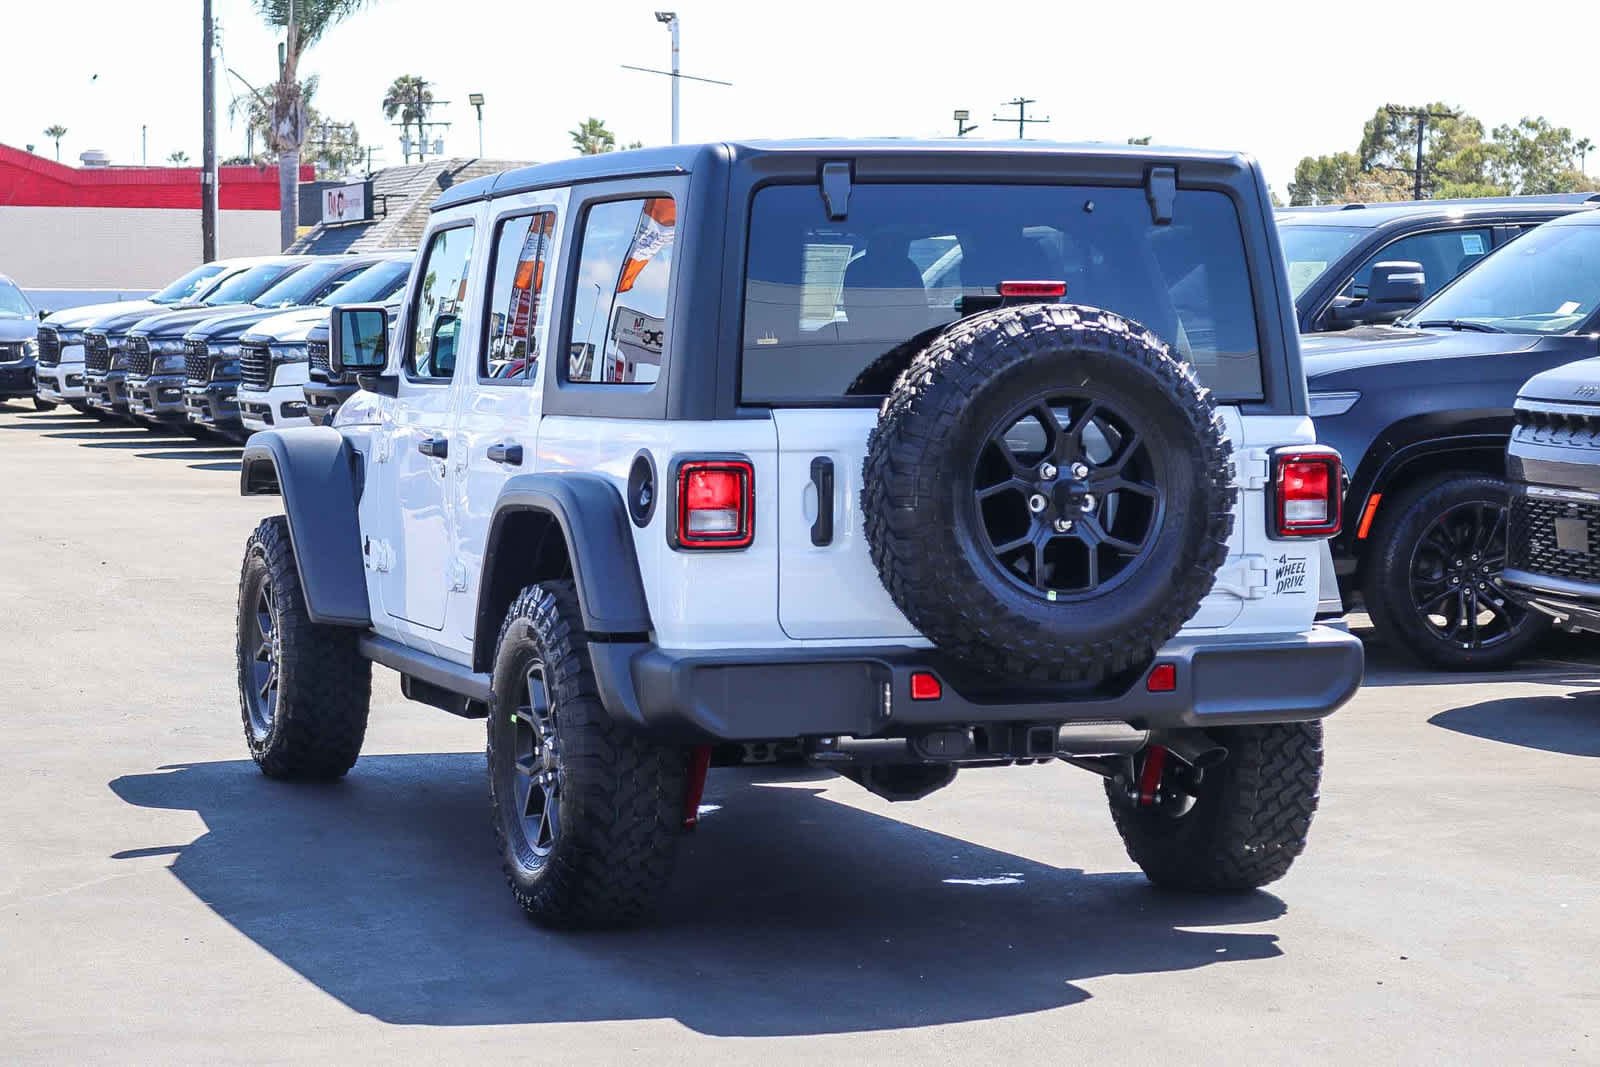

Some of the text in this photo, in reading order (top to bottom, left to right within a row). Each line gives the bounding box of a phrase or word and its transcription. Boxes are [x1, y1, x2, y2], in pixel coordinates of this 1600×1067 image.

[1279, 553, 1287, 565] 4
[1275, 562, 1306, 580] WHEEL
[1276, 575, 1306, 595] DRIVE
